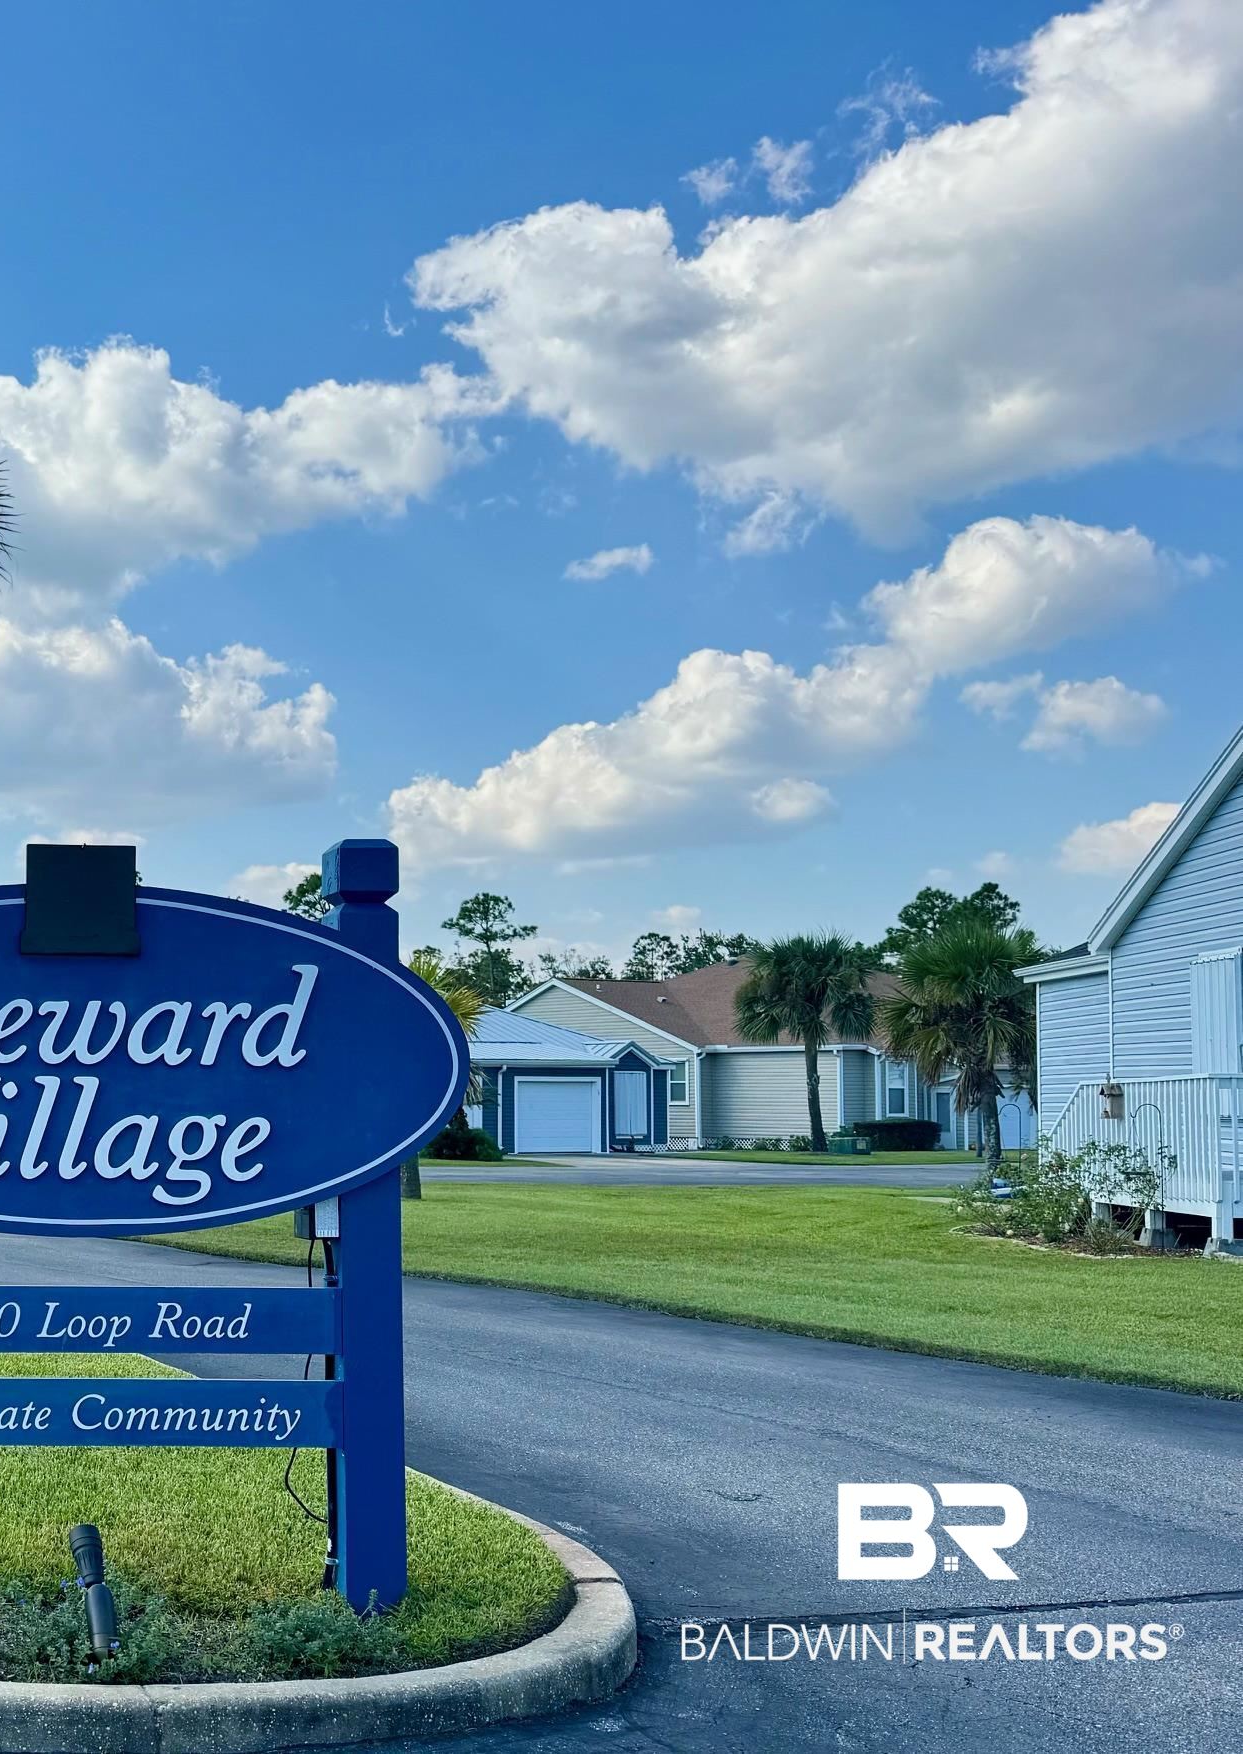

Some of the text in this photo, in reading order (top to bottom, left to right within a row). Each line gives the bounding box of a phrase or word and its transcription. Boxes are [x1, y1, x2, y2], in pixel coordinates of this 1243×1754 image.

[35, 1301, 132, 1348] Loop
[148, 1301, 253, 1340] Road
[71, 1392, 302, 1442] Community
